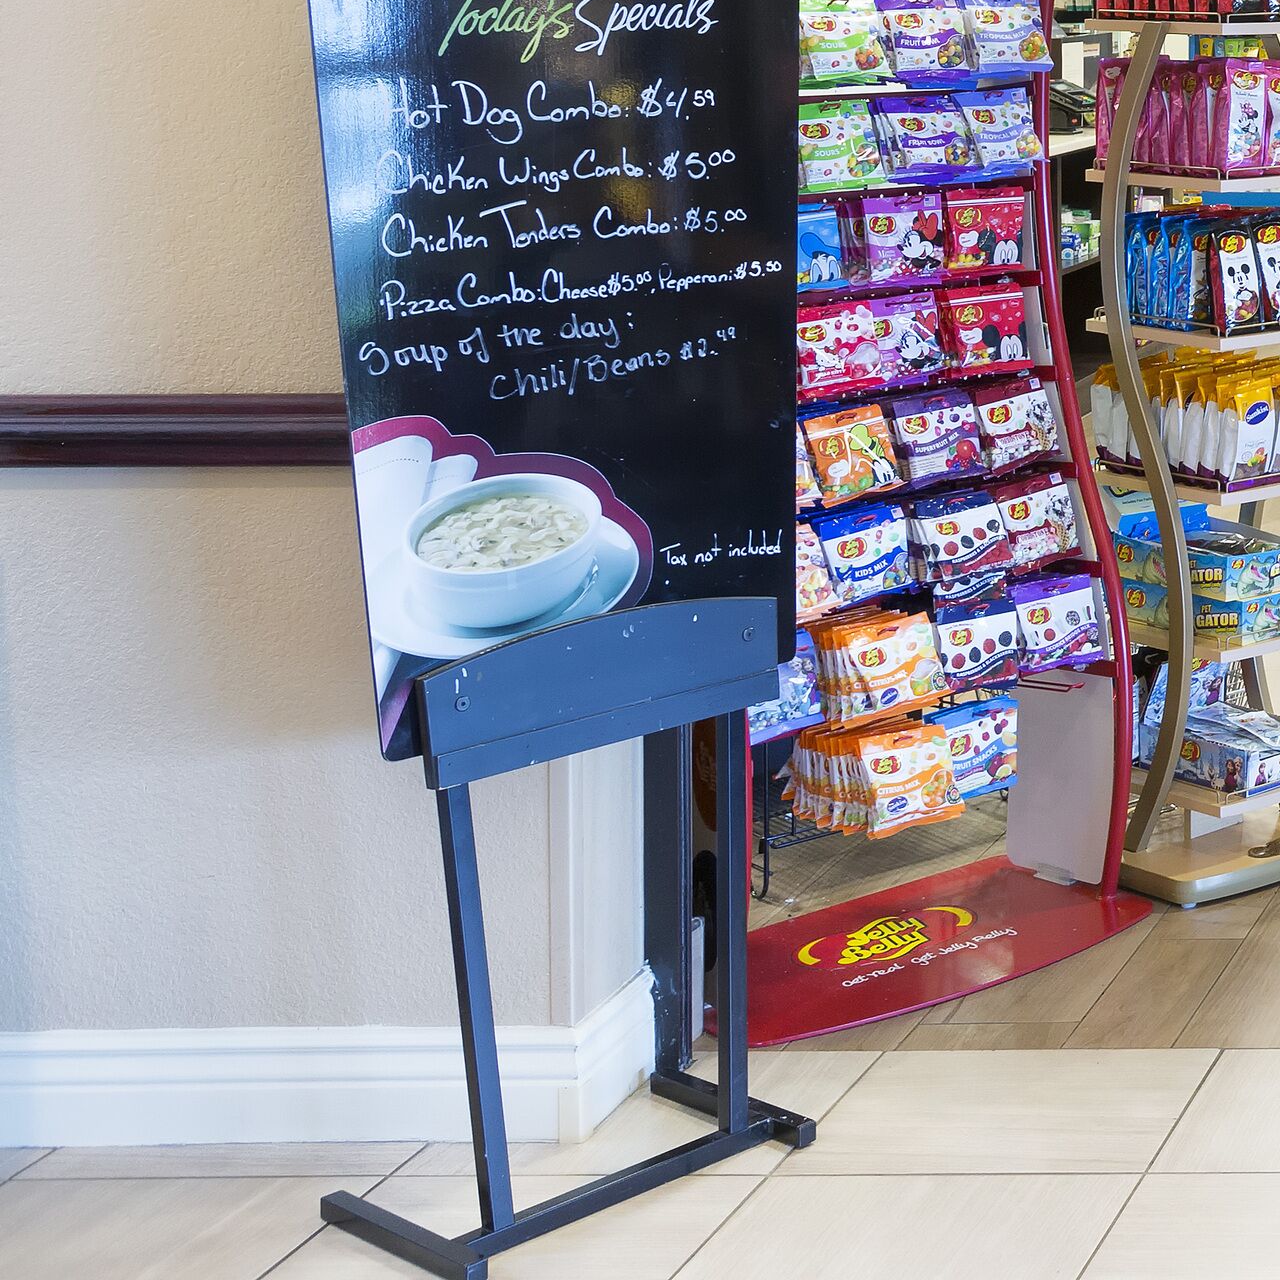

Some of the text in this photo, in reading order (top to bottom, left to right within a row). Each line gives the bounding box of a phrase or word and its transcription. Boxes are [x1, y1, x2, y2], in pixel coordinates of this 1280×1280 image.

[900, 38, 921, 47] FRUIT
[451, 80, 524, 145] Dog
[527, 79, 631, 122] Combo:
[814, 149, 841, 158] SOURS
[378, 147, 736, 195] Chicken Wings Combo: $5.00
[381, 200, 747, 258] Chicken Tenders Combo: $5.00
[379, 280, 457, 321] Pizza
[358, 340, 449, 376] Soup
[457, 326, 491, 364] of
[496, 323, 545, 350] the
[1246, 405, 1269, 423] Sunkist
[914, 439, 949, 454] SUPERFRUIT
[659, 528, 783, 566] Tax not included
[854, 558, 889, 579] KIDS MIX
[1191, 568, 1223, 582] ATOR
[1195, 613, 1239, 628] GATOR
[1201, 604, 1212, 613] PET
[953, 745, 998, 771] FRUIT SNACKS
[846, 916, 927, 946] Jelly
[837, 930, 929, 965] Belly
[867, 963, 905, 978] real
[910, 952, 937, 966] get
[938, 941, 979, 957] Jelly
